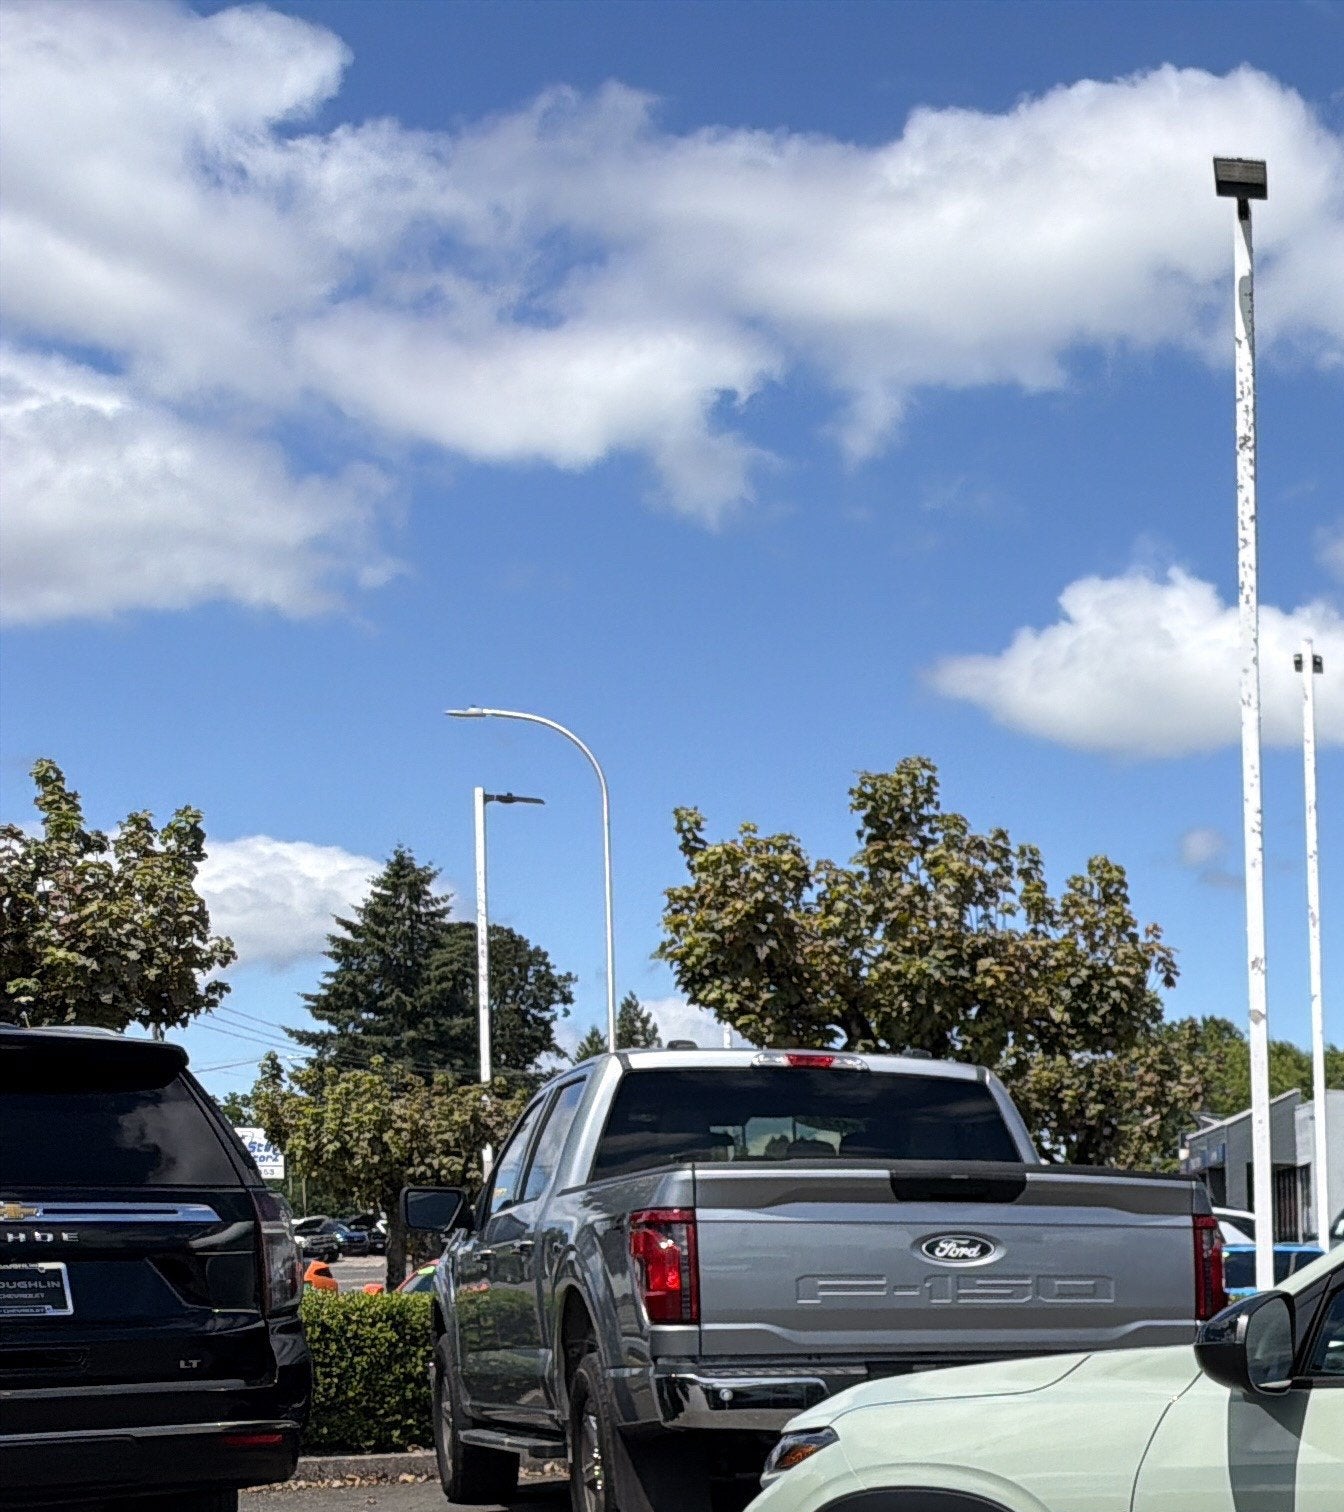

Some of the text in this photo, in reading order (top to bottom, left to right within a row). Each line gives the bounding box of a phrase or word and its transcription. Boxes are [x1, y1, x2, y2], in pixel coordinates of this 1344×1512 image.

[934, 1239, 981, 1260] Ford
[795, 1274, 1115, 1304] F-150
[180, 1359, 202, 1369] LT
